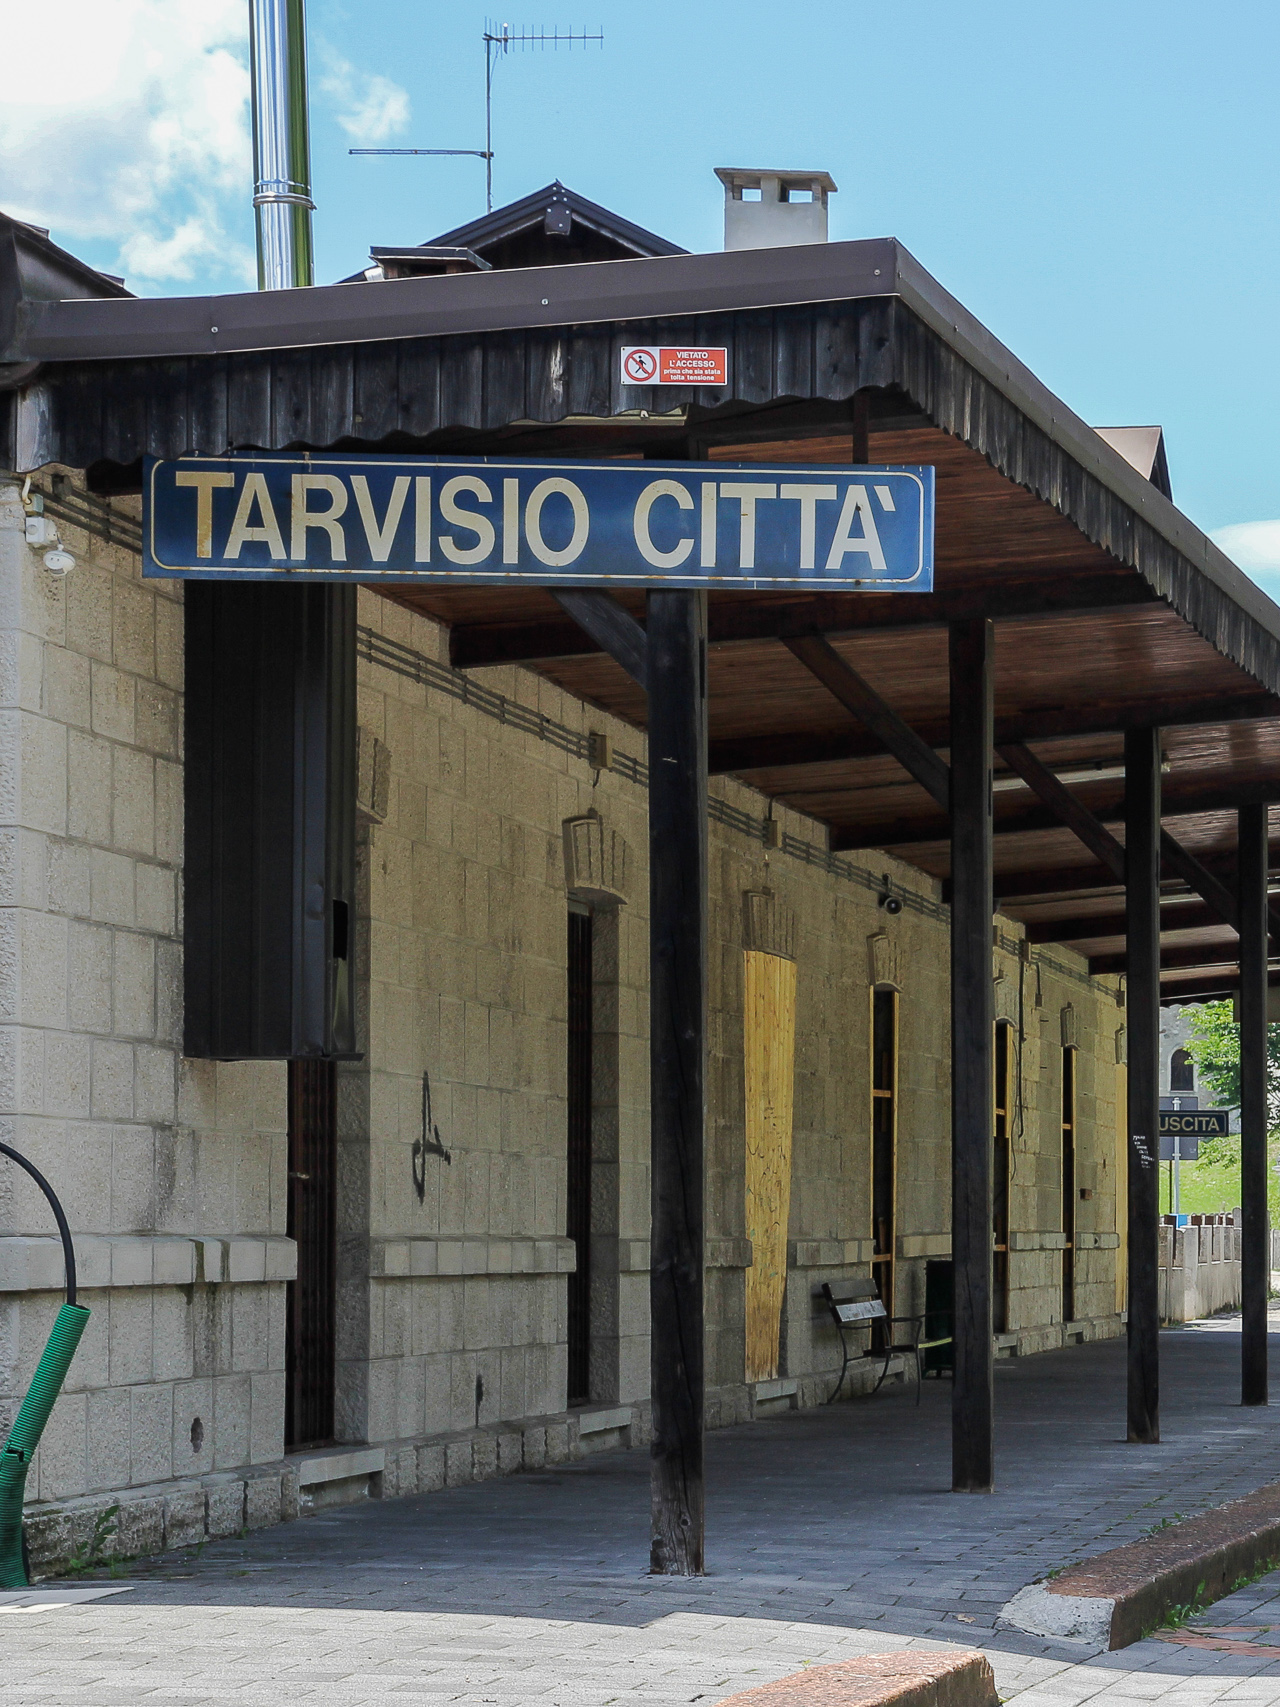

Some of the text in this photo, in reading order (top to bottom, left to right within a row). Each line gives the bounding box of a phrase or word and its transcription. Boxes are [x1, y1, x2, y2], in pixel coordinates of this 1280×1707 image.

[676, 351, 709, 359] VIETATO
[669, 360, 715, 368] L'ACCESSO
[175, 471, 590, 567] TARVISIO
[1159, 1116, 1220, 1131] USCITA
